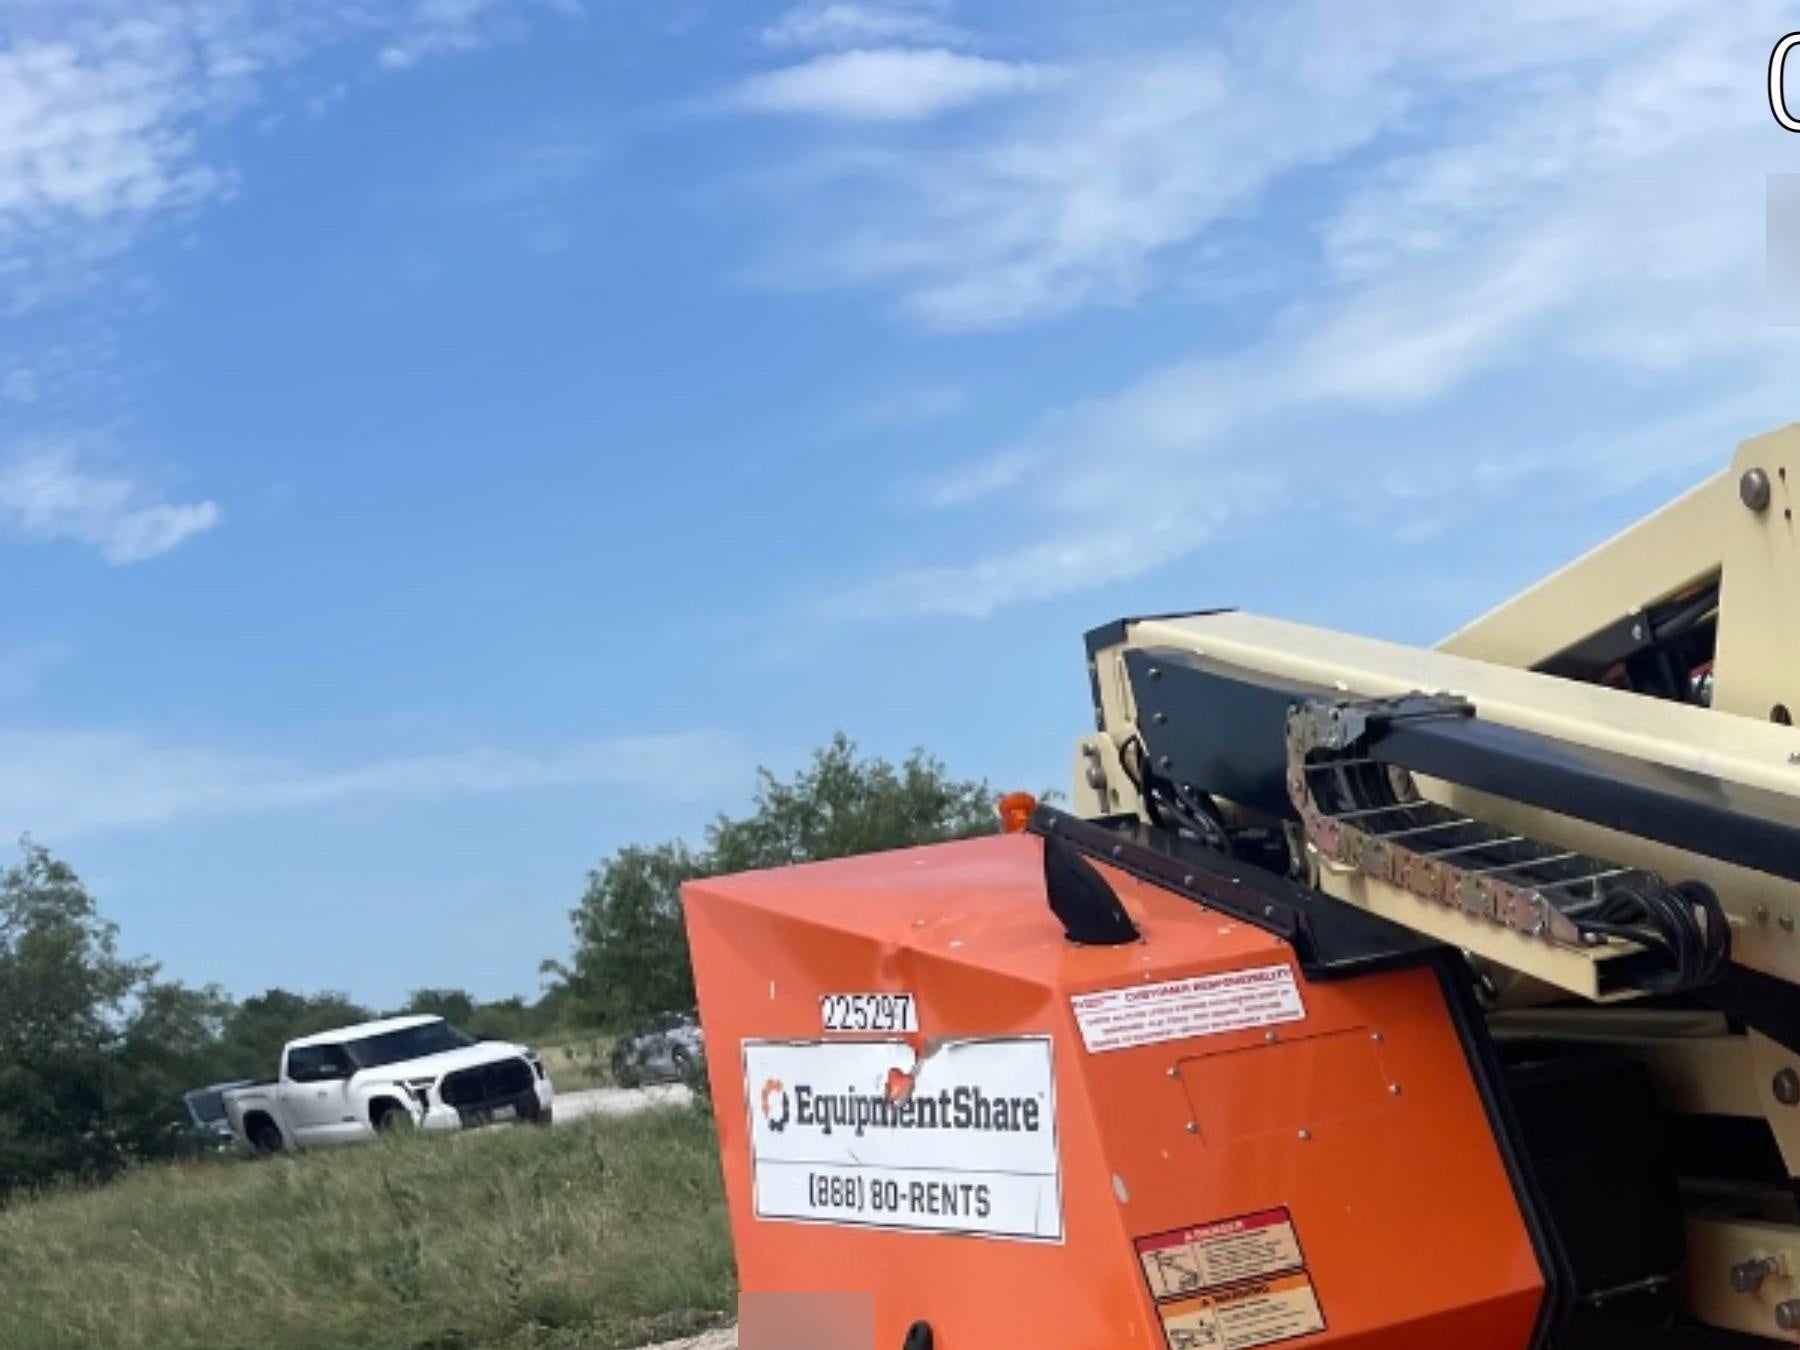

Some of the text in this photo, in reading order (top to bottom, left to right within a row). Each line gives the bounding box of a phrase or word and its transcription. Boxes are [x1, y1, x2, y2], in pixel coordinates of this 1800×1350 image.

[822, 995, 910, 1030] 225297
[794, 1085, 1039, 1136] EquipmentShare
[809, 1173, 991, 1218] (888) 80-RENTS
